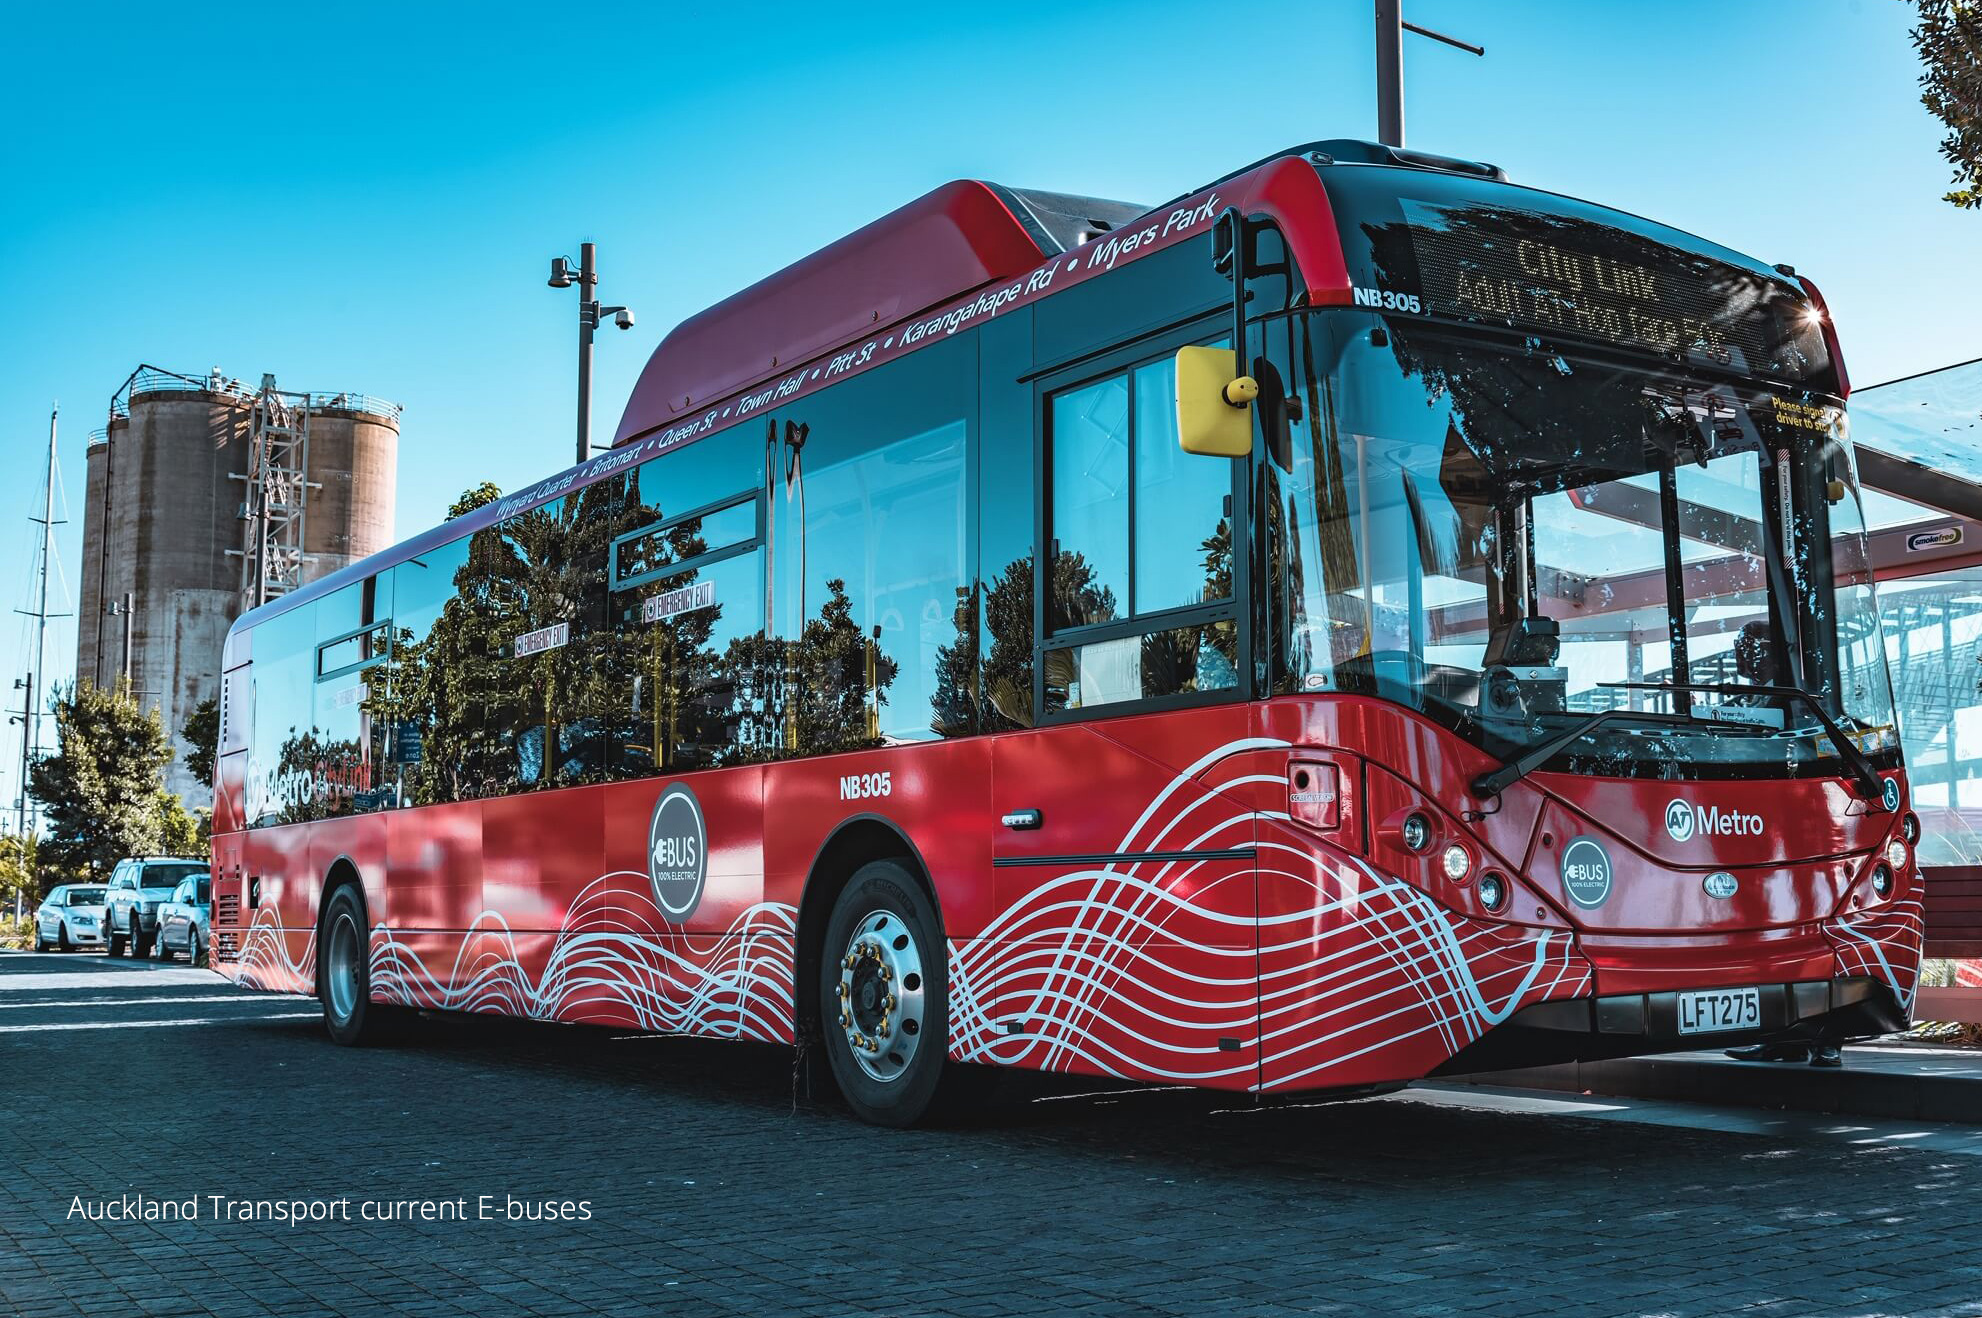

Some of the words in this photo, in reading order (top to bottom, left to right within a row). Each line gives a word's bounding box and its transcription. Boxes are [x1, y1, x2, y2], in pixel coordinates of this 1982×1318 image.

[1518, 239, 1582, 291] City
[1593, 256, 1660, 301] Link
[1353, 286, 1421, 314] NB305
[496, 486, 540, 519] Wynyard
[537, 473, 578, 500] Quarter
[589, 442, 644, 478] Britomart
[658, 421, 701, 449] Queen
[700, 410, 719, 432] St
[735, 393, 772, 417] Town
[773, 369, 809, 401] Hall
[825, 352, 857, 379] Pitt
[856, 342, 877, 363] St
[899, 284, 1021, 348] Karangahape
[1024, 261, 1062, 296] Rd
[1087, 223, 1158, 270] Myers
[1162, 193, 1222, 237] Park
[1771, 396, 1802, 413] Please
[1803, 403, 1826, 419] signal
[1776, 411, 1803, 427] driver
[1803, 418, 1814, 429] to
[1914, 533, 1955, 546] smokefree
[657, 587, 694, 618] EMERGENCY
[695, 582, 711, 609] EXIT
[524, 629, 551, 654] EMERGENCY
[553, 624, 565, 646] EXIT
[840, 772, 892, 800] NB305
[1668, 810, 1690, 829] AT
[1697, 806, 1763, 836] Metro
[658, 871, 671, 881] 100%
[671, 870, 697, 880] ELECTRIC
[1681, 993, 1758, 1028] LFT275
